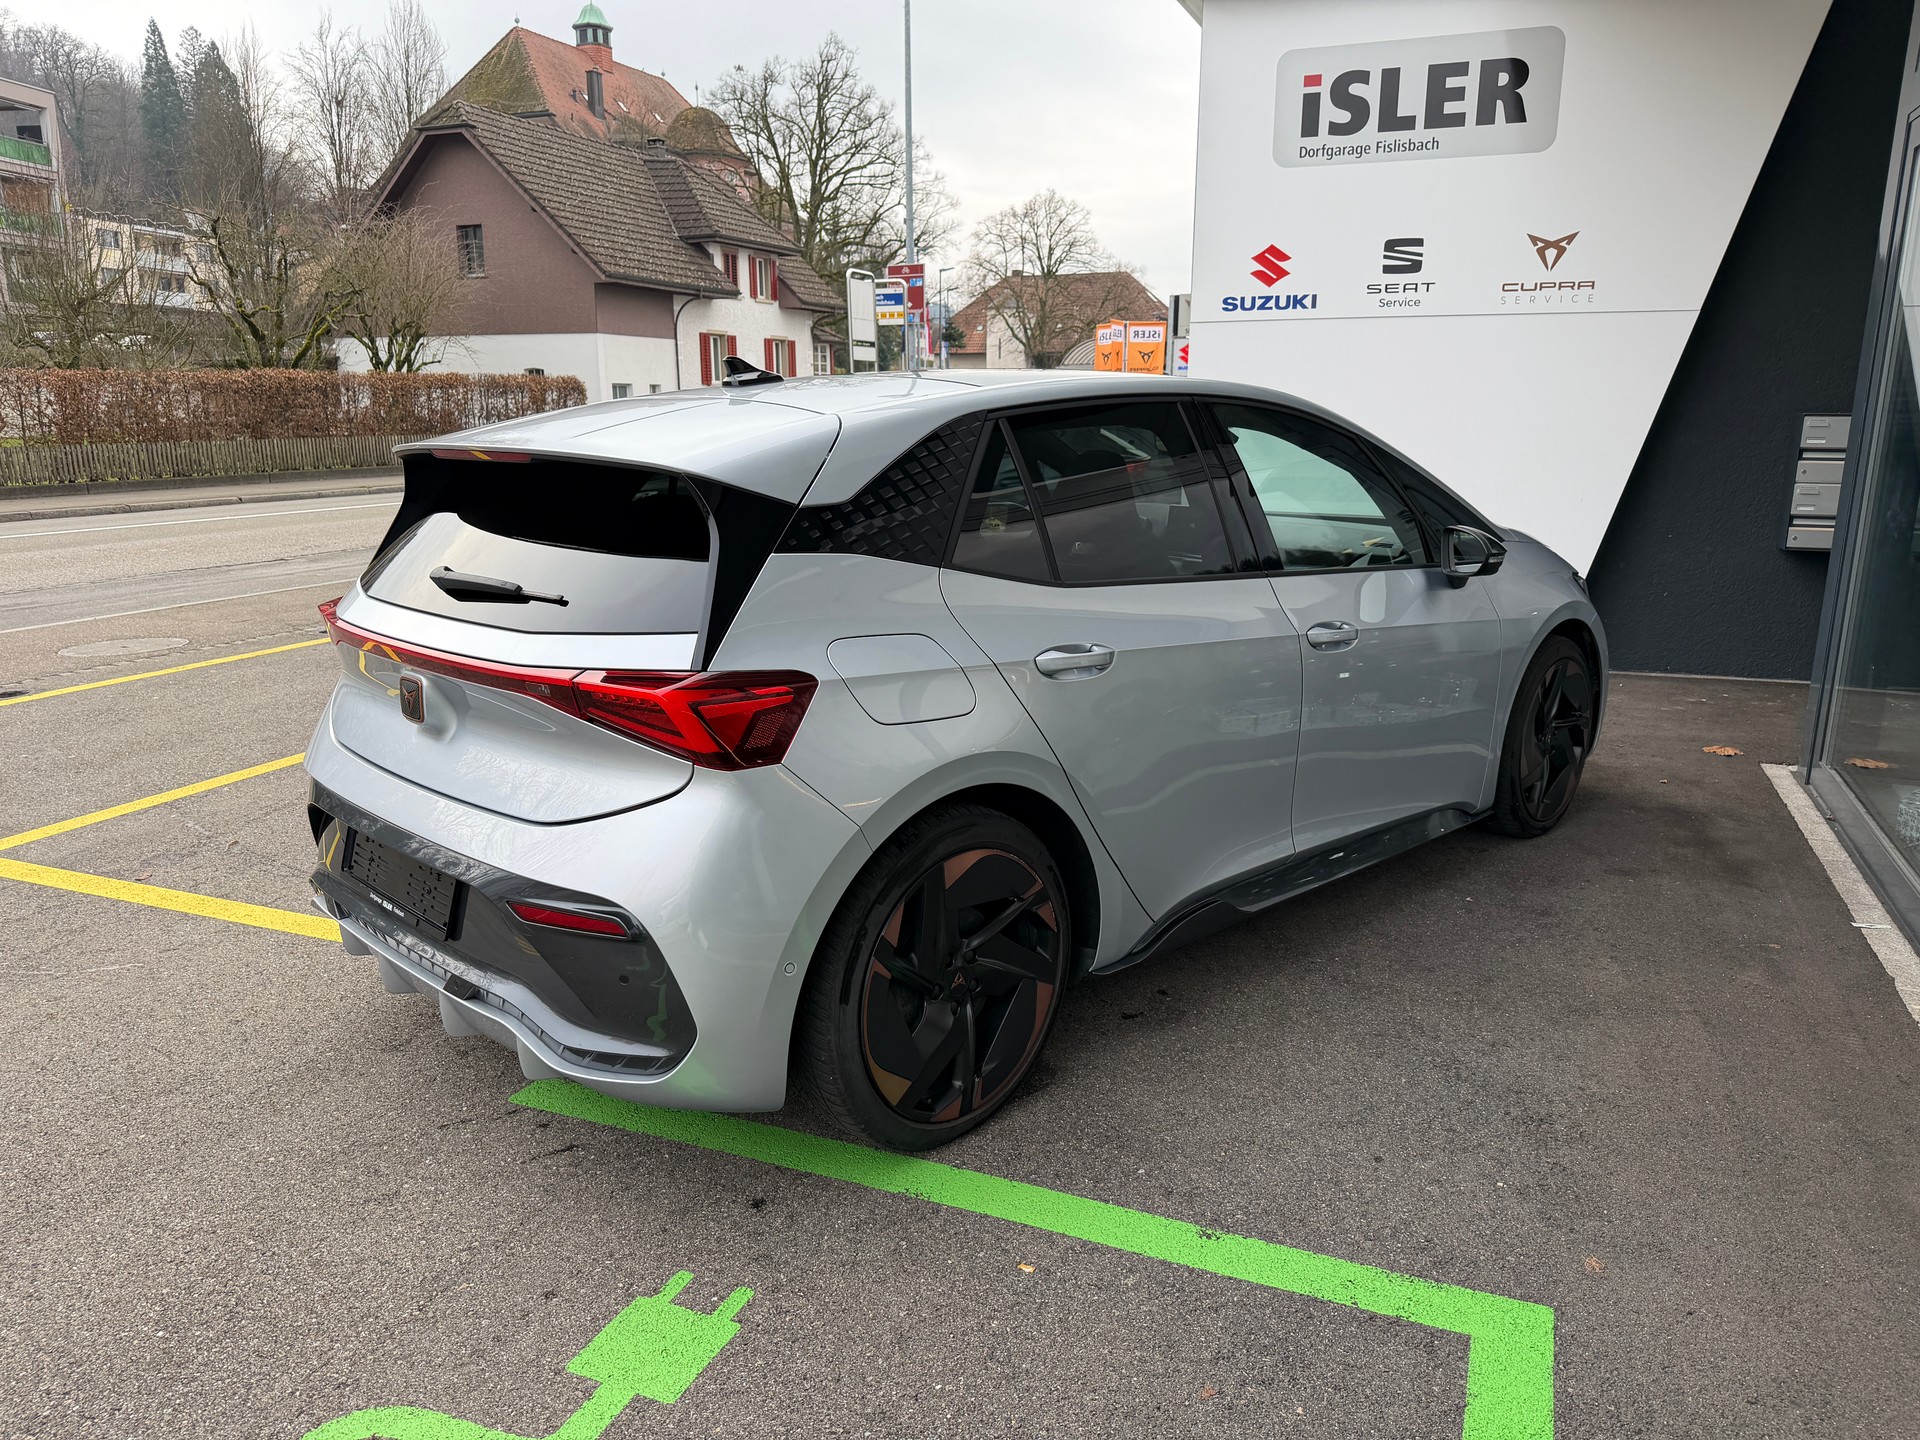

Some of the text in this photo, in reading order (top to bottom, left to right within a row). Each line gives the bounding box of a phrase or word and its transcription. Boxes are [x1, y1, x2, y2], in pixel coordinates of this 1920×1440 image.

[1300, 57, 1530, 139] iSLER
[1299, 136, 1440, 161] Dorfgarage Fislisbach
[1366, 281, 1435, 294] SEAT
[1501, 280, 1595, 292] CUPRA
[1221, 293, 1318, 312] SUZUKI
[1378, 297, 1421, 308] Service
[1500, 293, 1595, 305] SERVICE
